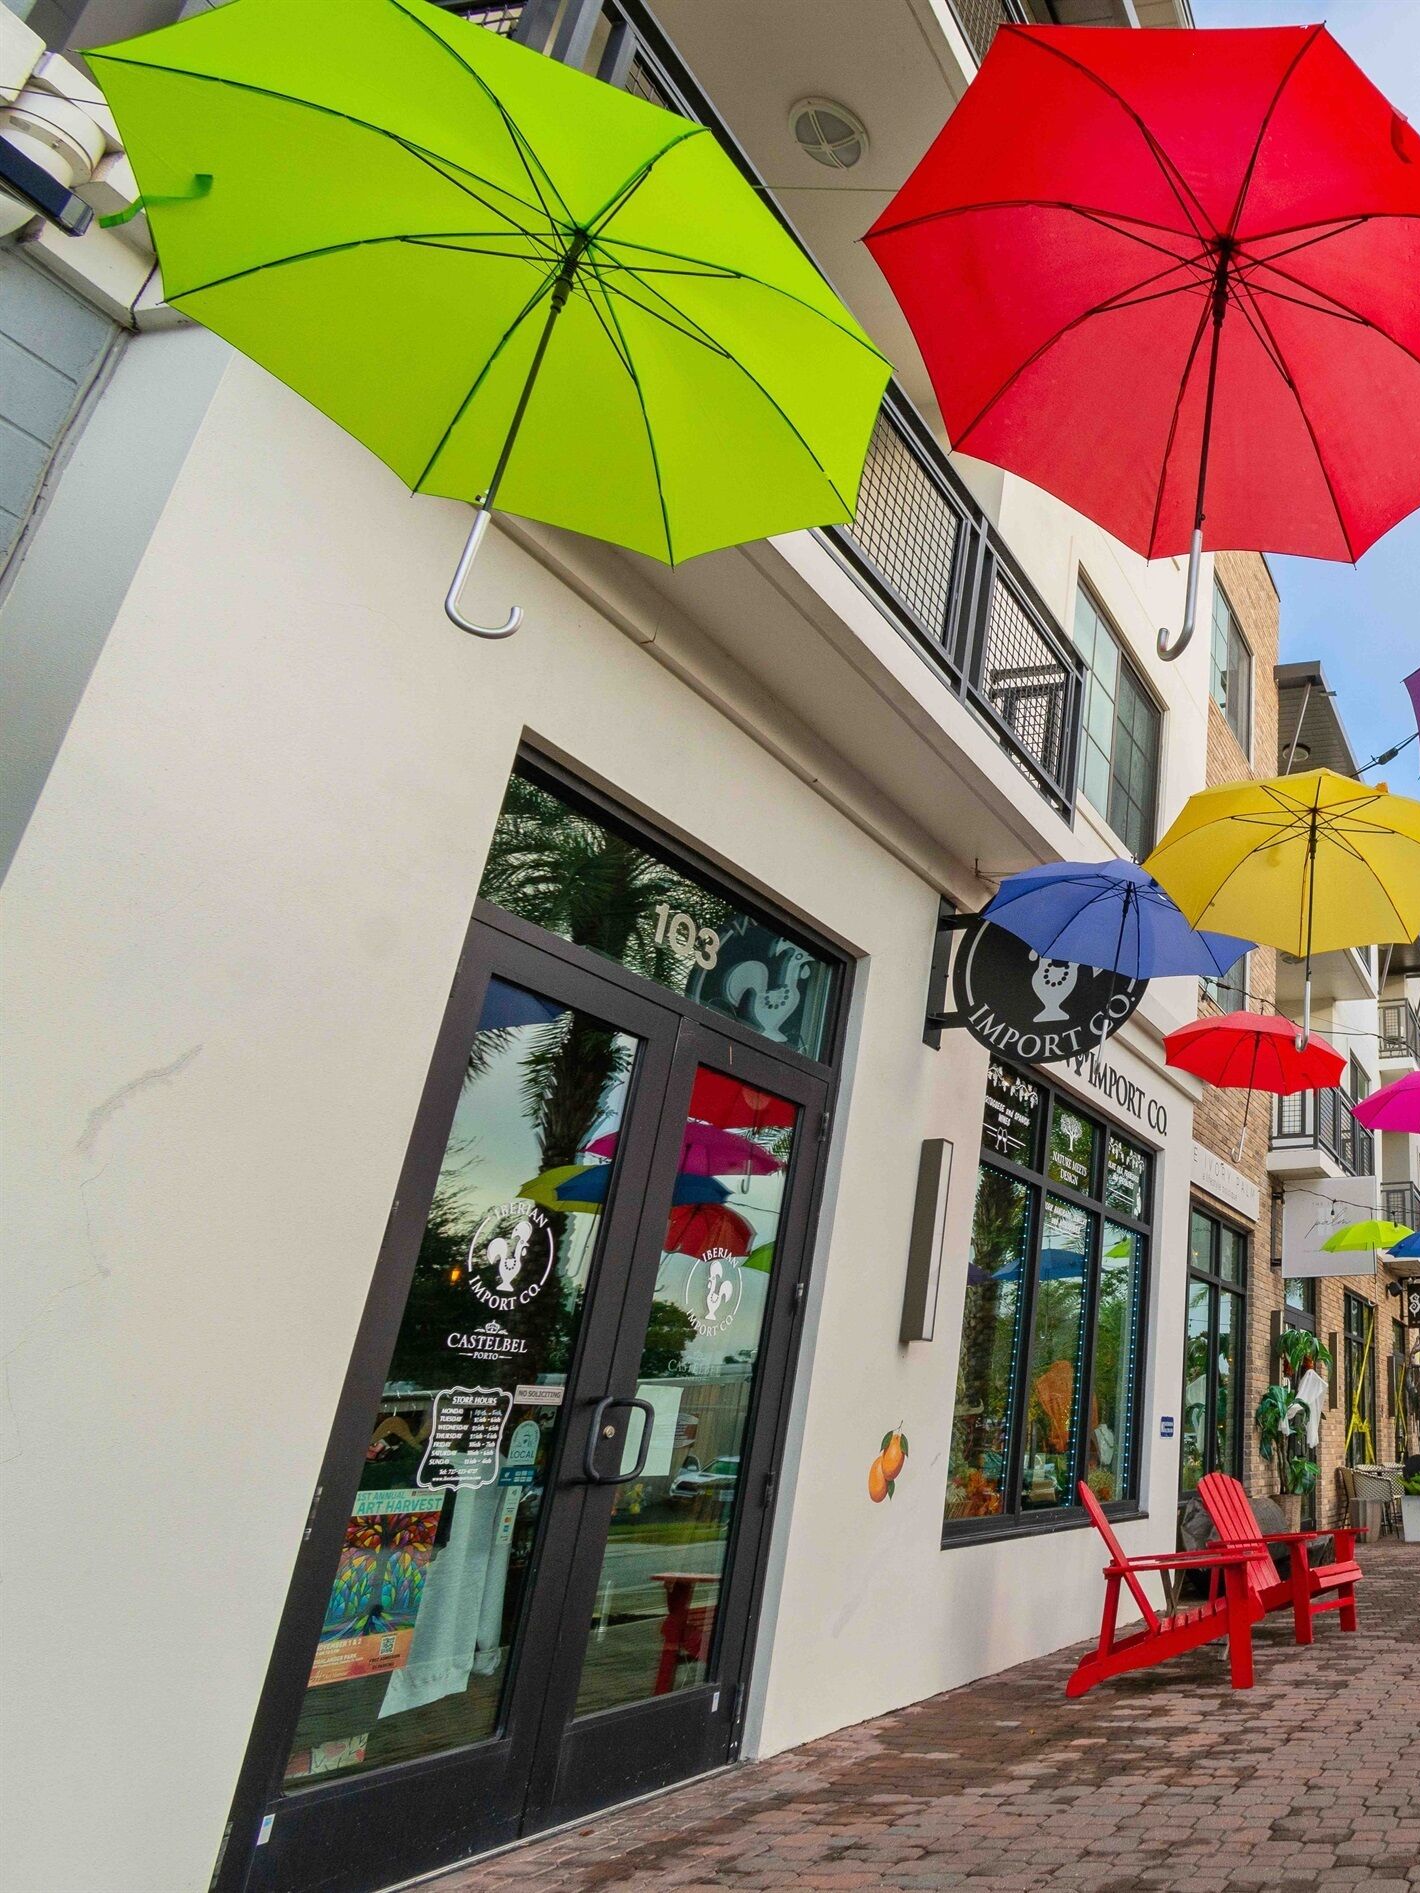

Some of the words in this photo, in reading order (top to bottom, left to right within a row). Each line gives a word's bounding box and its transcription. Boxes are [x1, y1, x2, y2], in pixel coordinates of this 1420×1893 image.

[655, 902, 720, 970] 103
[968, 1002, 1082, 1058] IMPORT
[1089, 993, 1136, 1036] CO.
[1088, 1051, 1146, 1121] IMPORT
[1147, 1099, 1168, 1137] CO.
[1052, 1151, 1072, 1169] NATURE
[1071, 1161, 1088, 1177] MEETS
[1060, 1169, 1078, 1186] DESIGN
[495, 1201, 549, 1229] IBERIAN
[702, 1247, 739, 1269] IBERIAN
[468, 1274, 517, 1311] IMPORT
[686, 1308, 719, 1337] IMPORT
[447, 1332, 528, 1354] CASTELBEL
[472, 1351, 499, 1360] PORTO
[452, 1396, 474, 1404] STORE
[474, 1397, 498, 1405] HOURS
[518, 1389, 528, 1398] NO
[527, 1390, 561, 1399] SOLICITING
[509, 1450, 535, 1459] LOCAL
[357, 1501, 384, 1515] ART
[386, 1497, 443, 1512] HARVEST
[373, 1491, 406, 1500] ANNUAL
[319, 1641, 347, 1651] OVEMBER
